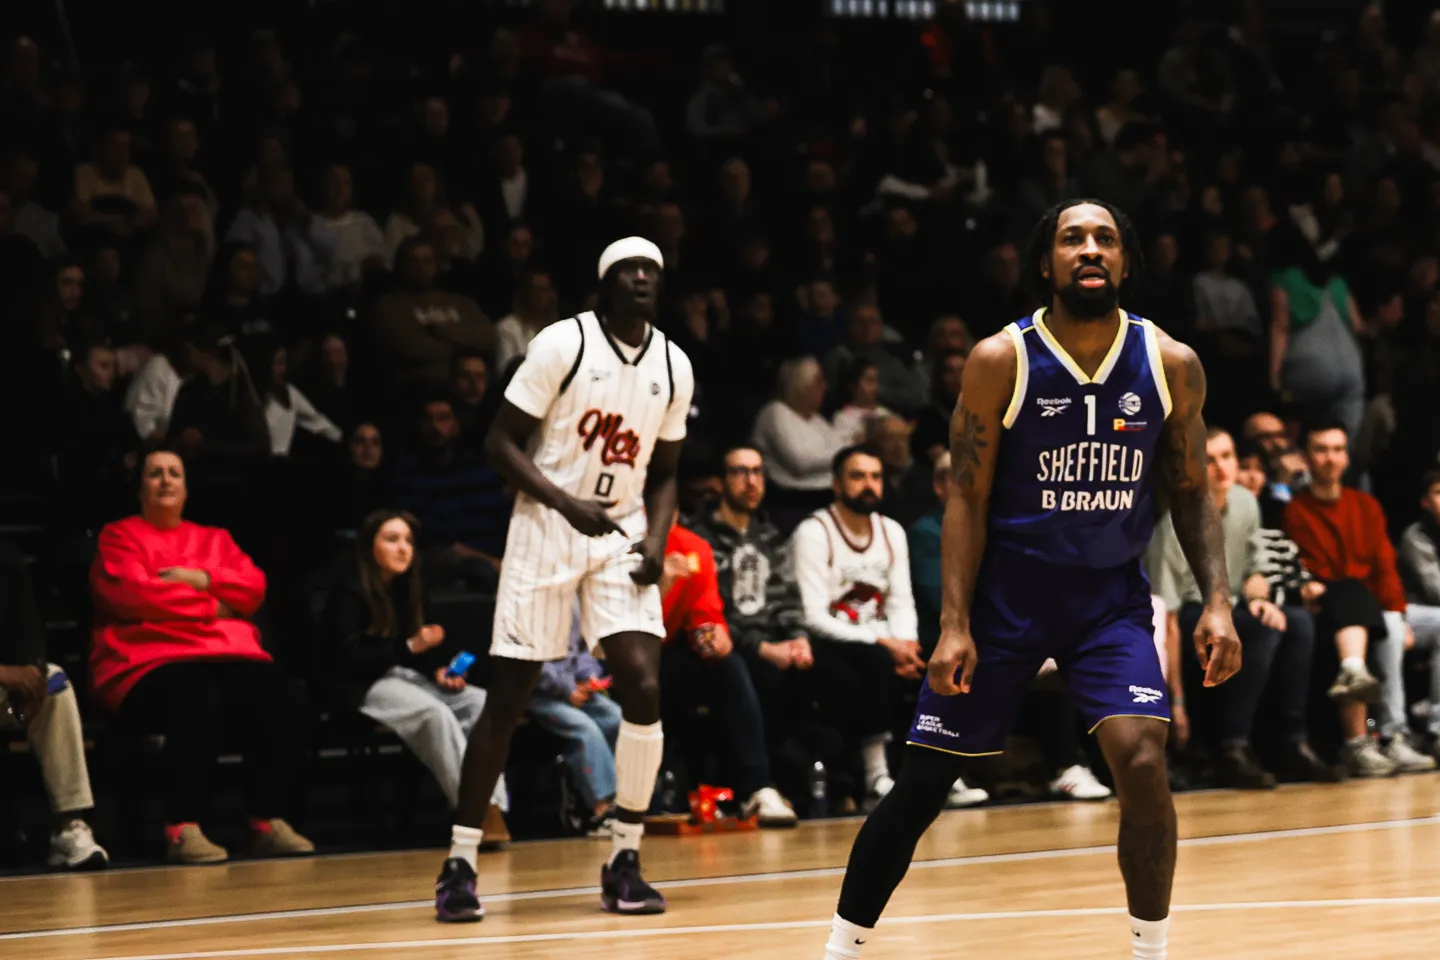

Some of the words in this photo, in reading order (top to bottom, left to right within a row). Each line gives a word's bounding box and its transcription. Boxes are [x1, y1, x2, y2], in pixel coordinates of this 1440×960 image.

[1084, 395, 1096, 435] 1
[1037, 442, 1144, 482] SHEFFIELD
[594, 472, 615, 497] 0
[1042, 490, 1056, 510] B
[1060, 489, 1134, 512] BRAUN
